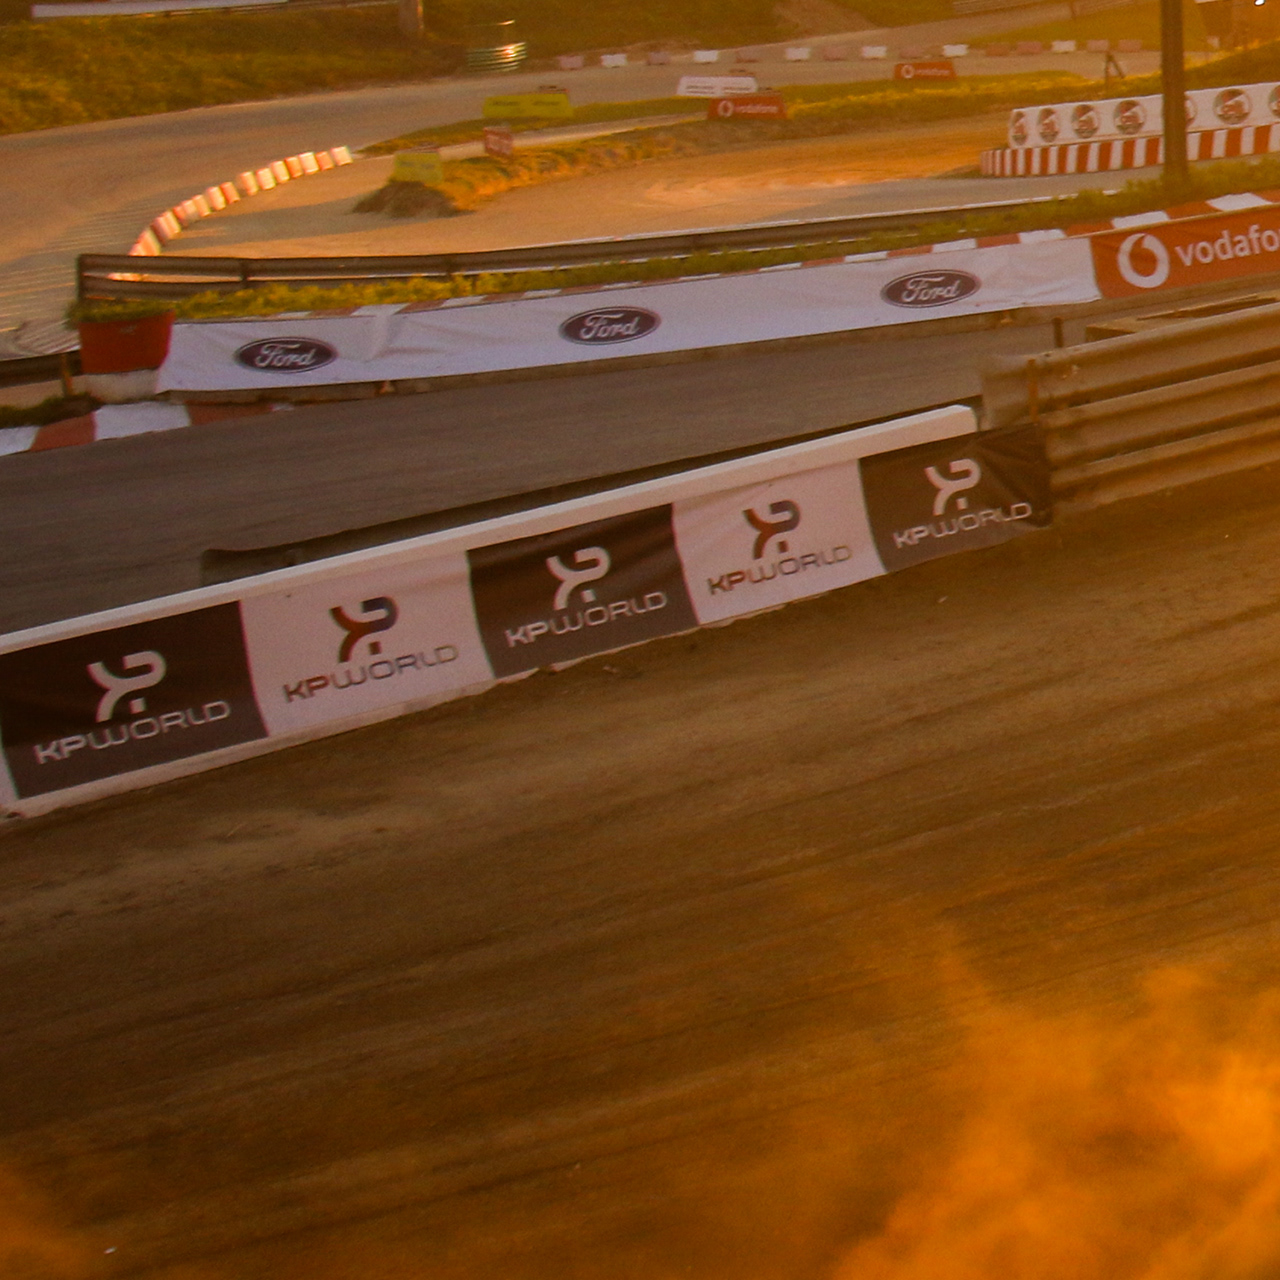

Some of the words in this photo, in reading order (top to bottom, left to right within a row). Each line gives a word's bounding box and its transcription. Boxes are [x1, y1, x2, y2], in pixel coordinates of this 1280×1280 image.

[900, 276, 961, 304] Ford
[579, 312, 640, 340] Ford
[255, 343, 317, 368] Ford
[892, 501, 1032, 549] KPWORLD
[707, 544, 853, 595] KPWORLD
[504, 591, 668, 648] KPWORLD
[283, 644, 459, 704] KPWORLD
[33, 699, 231, 764] KPWORLD
